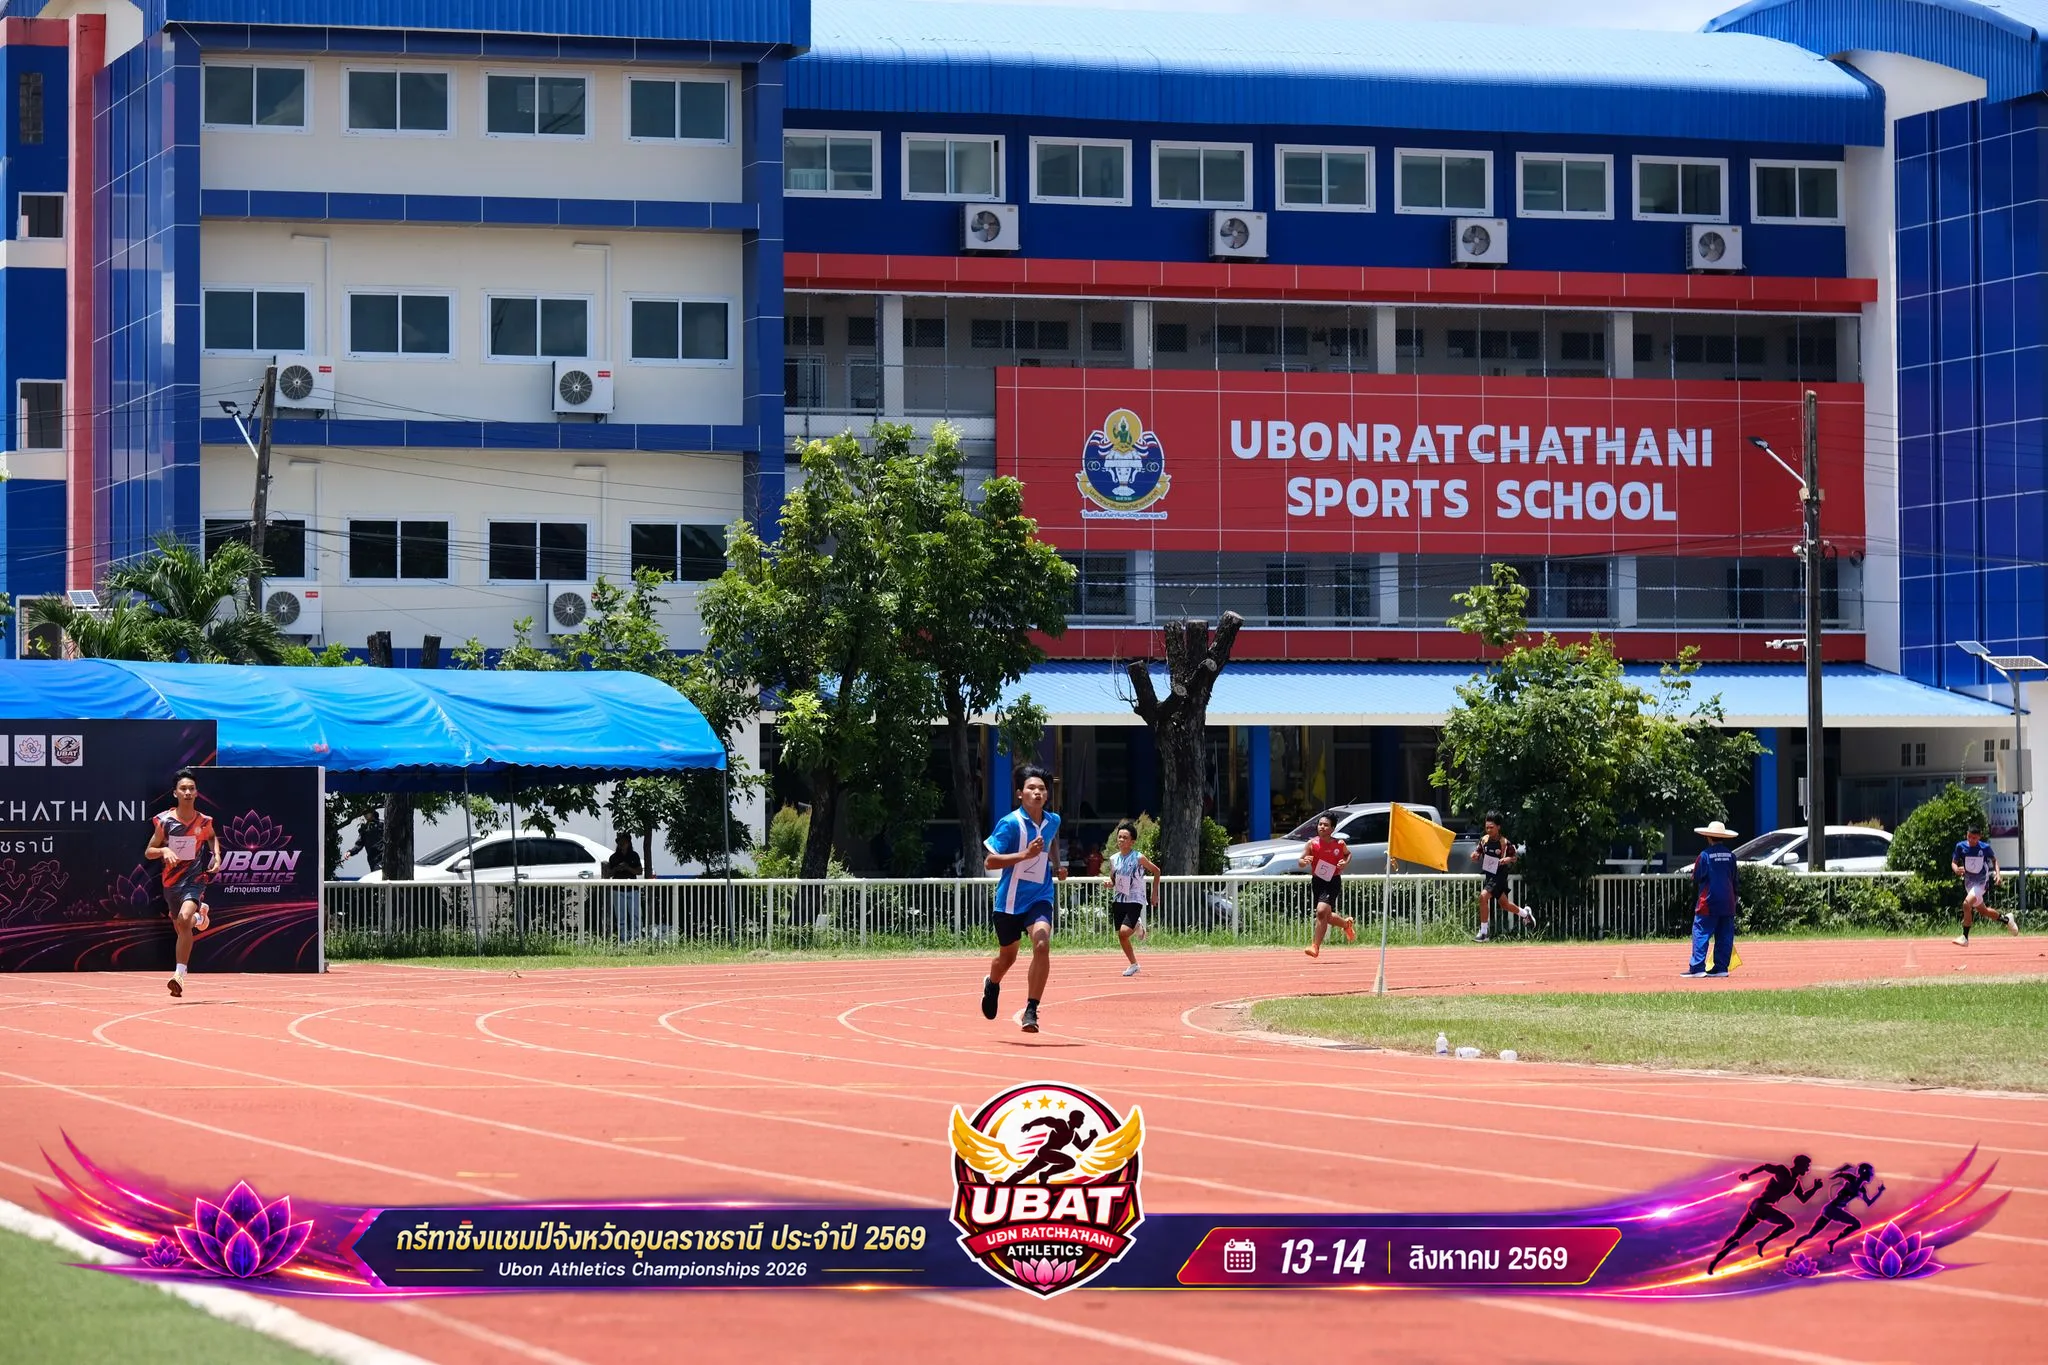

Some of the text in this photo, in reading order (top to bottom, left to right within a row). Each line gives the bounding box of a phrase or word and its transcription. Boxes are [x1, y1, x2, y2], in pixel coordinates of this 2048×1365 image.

[1230, 420, 1713, 467] UBONRATCHATHANI
[1286, 476, 1677, 521] SPORTS SCHOOL
[176, 840, 187, 854] 7
[212, 871, 296, 883] ATHLETICS
[1320, 864, 1329, 876] 5
